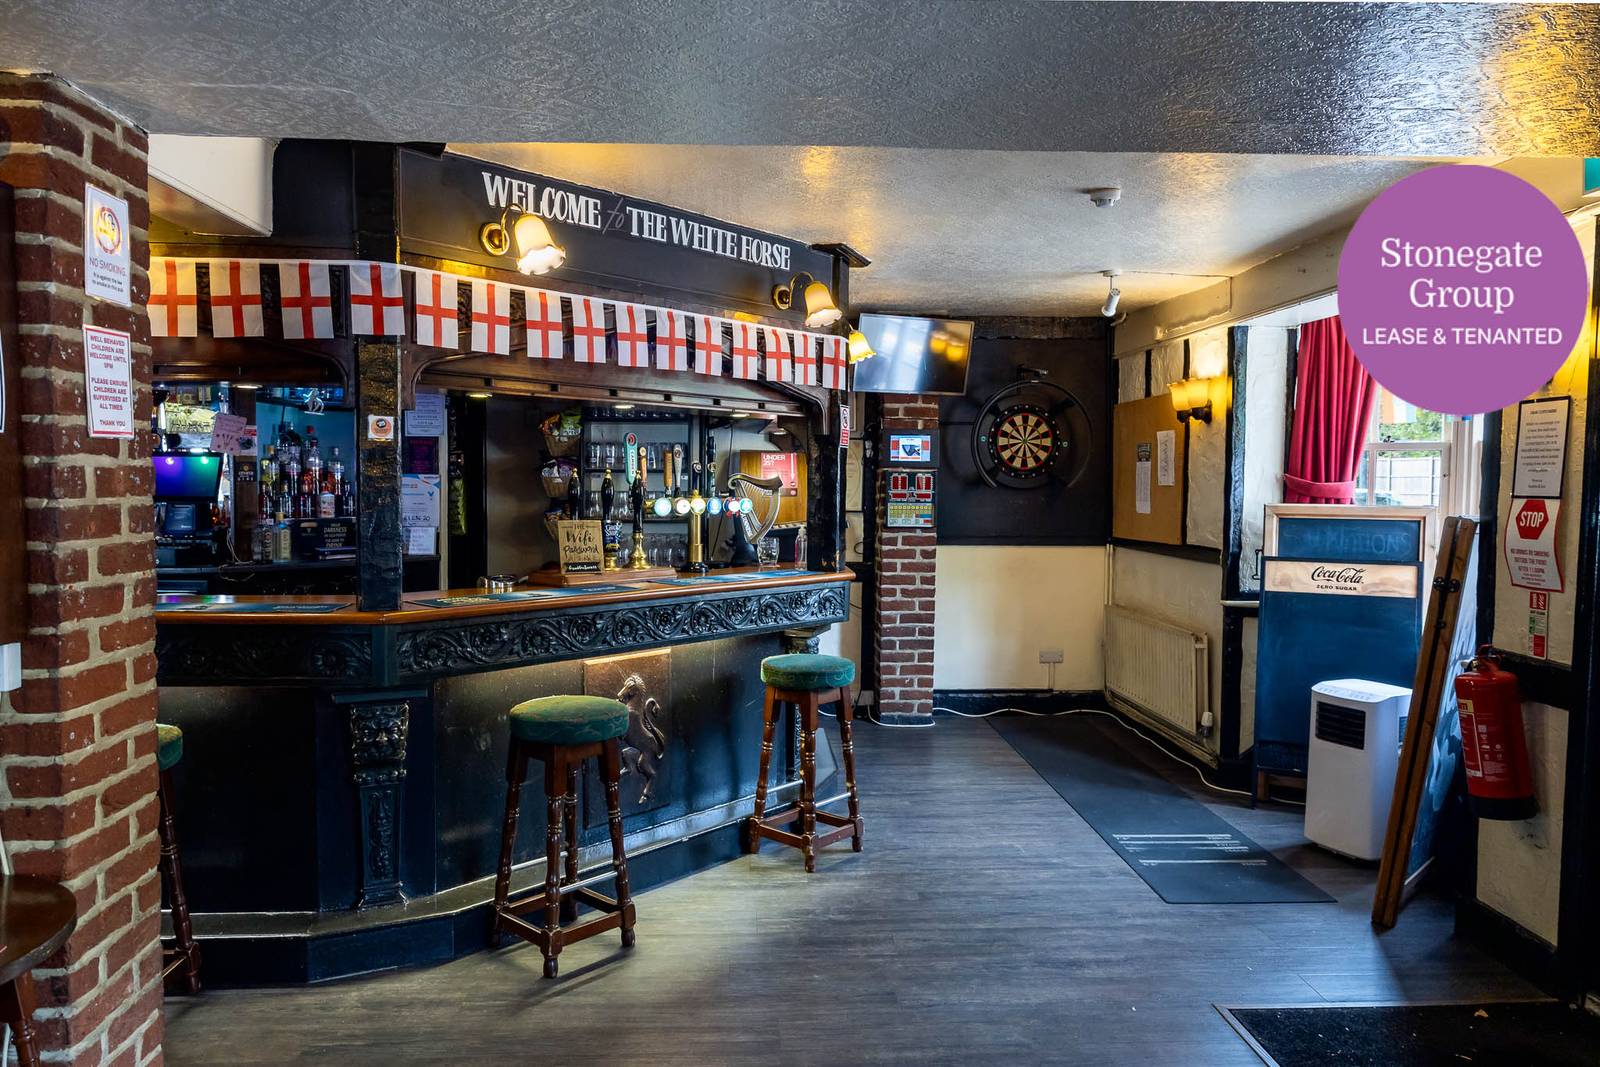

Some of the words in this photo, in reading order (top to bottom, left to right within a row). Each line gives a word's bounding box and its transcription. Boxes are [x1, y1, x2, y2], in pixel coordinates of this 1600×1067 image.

[481, 171, 601, 228] WELCOME
[602, 198, 625, 235] to
[626, 206, 667, 242] THE
[669, 216, 738, 258] WHITE
[740, 235, 791, 271] HORSE
[89, 257, 99, 268] NO
[100, 260, 126, 276] SMOKING
[90, 335, 103, 343] WELL
[104, 337, 125, 346] BEHAVED
[91, 344, 114, 352] CHILDREN
[90, 352, 112, 360] WELCOME
[91, 377, 108, 386] PLEASE
[93, 394, 122, 402] SUPERVISED
[1520, 510, 1545, 528] STOP
[566, 530, 593, 546] Wifi
[1311, 566, 1366, 584] Coca-Cola
